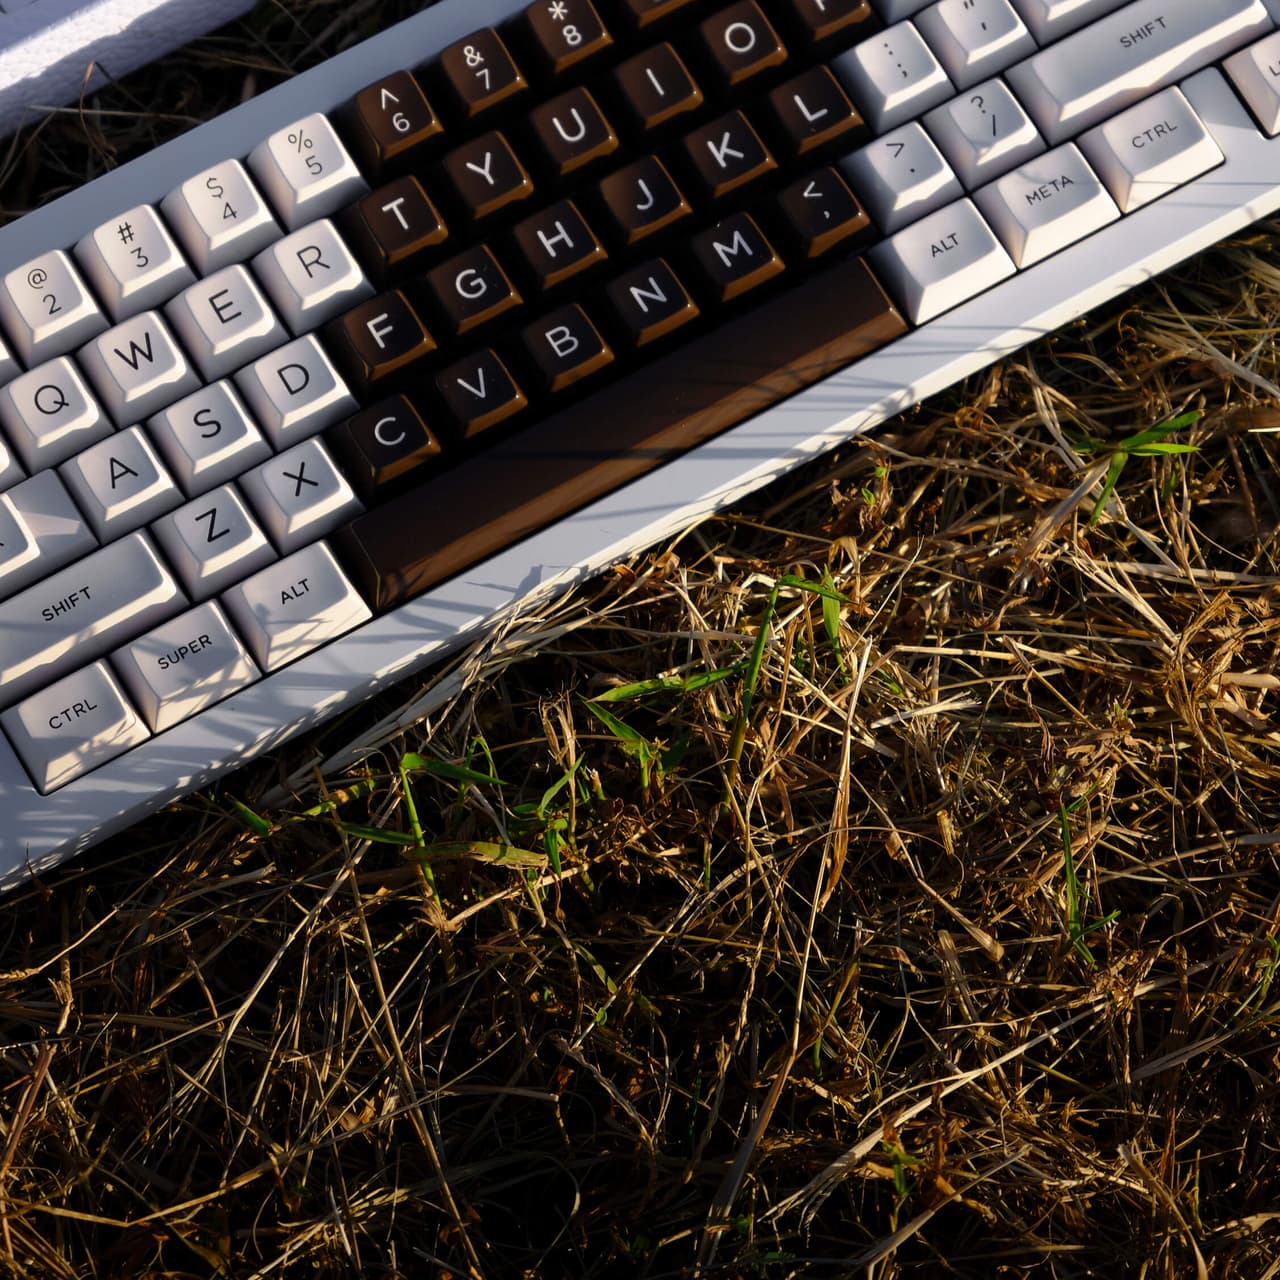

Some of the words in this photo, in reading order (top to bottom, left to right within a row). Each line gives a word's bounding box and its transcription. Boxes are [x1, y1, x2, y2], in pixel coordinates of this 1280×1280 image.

[563, 25, 581, 45] 8
[725, 23, 755, 52] O
[1120, 16, 1165, 48] SHIFT
[464, 46, 484, 66] &
[476, 69, 489, 89] 7
[646, 69, 664, 95] I
[794, 95, 827, 121] L
[971, 96, 986, 113] ?
[393, 113, 410, 132] 6
[552, 108, 585, 141] U
[1132, 121, 1177, 148] CTRL
[288, 129, 312, 153] %
[707, 132, 744, 167] K
[886, 143, 904, 158] >
[305, 155, 322, 175] 5
[466, 152, 494, 184] Y
[637, 179, 653, 210] J
[803, 181, 822, 197] <
[1026, 176, 1074, 205] META
[223, 202, 237, 219] 4
[382, 198, 408, 229] T
[118, 222, 134, 244] #
[537, 221, 573, 257] H
[931, 233, 958, 257] ALT
[130, 247, 148, 267] 3
[296, 246, 330, 278] R
[713, 231, 752, 267] M
[28, 269, 47, 289] @
[456, 269, 486, 298] G
[43, 294, 62, 315] 2
[209, 288, 242, 325] E
[630, 277, 666, 312] N
[367, 313, 392, 348] F
[545, 326, 578, 357] B
[114, 332, 153, 370] W
[277, 364, 309, 395] D
[457, 368, 485, 398] V
[34, 385, 69, 414] Q
[194, 409, 221, 438] S
[375, 417, 405, 445] C
[110, 457, 138, 489] A
[283, 462, 318, 496] X
[195, 508, 230, 542] Z
[42, 586, 90, 621] SHIFT
[282, 578, 309, 604] ALT
[158, 635, 212, 669] SUPER
[49, 700, 97, 729] CTRL
